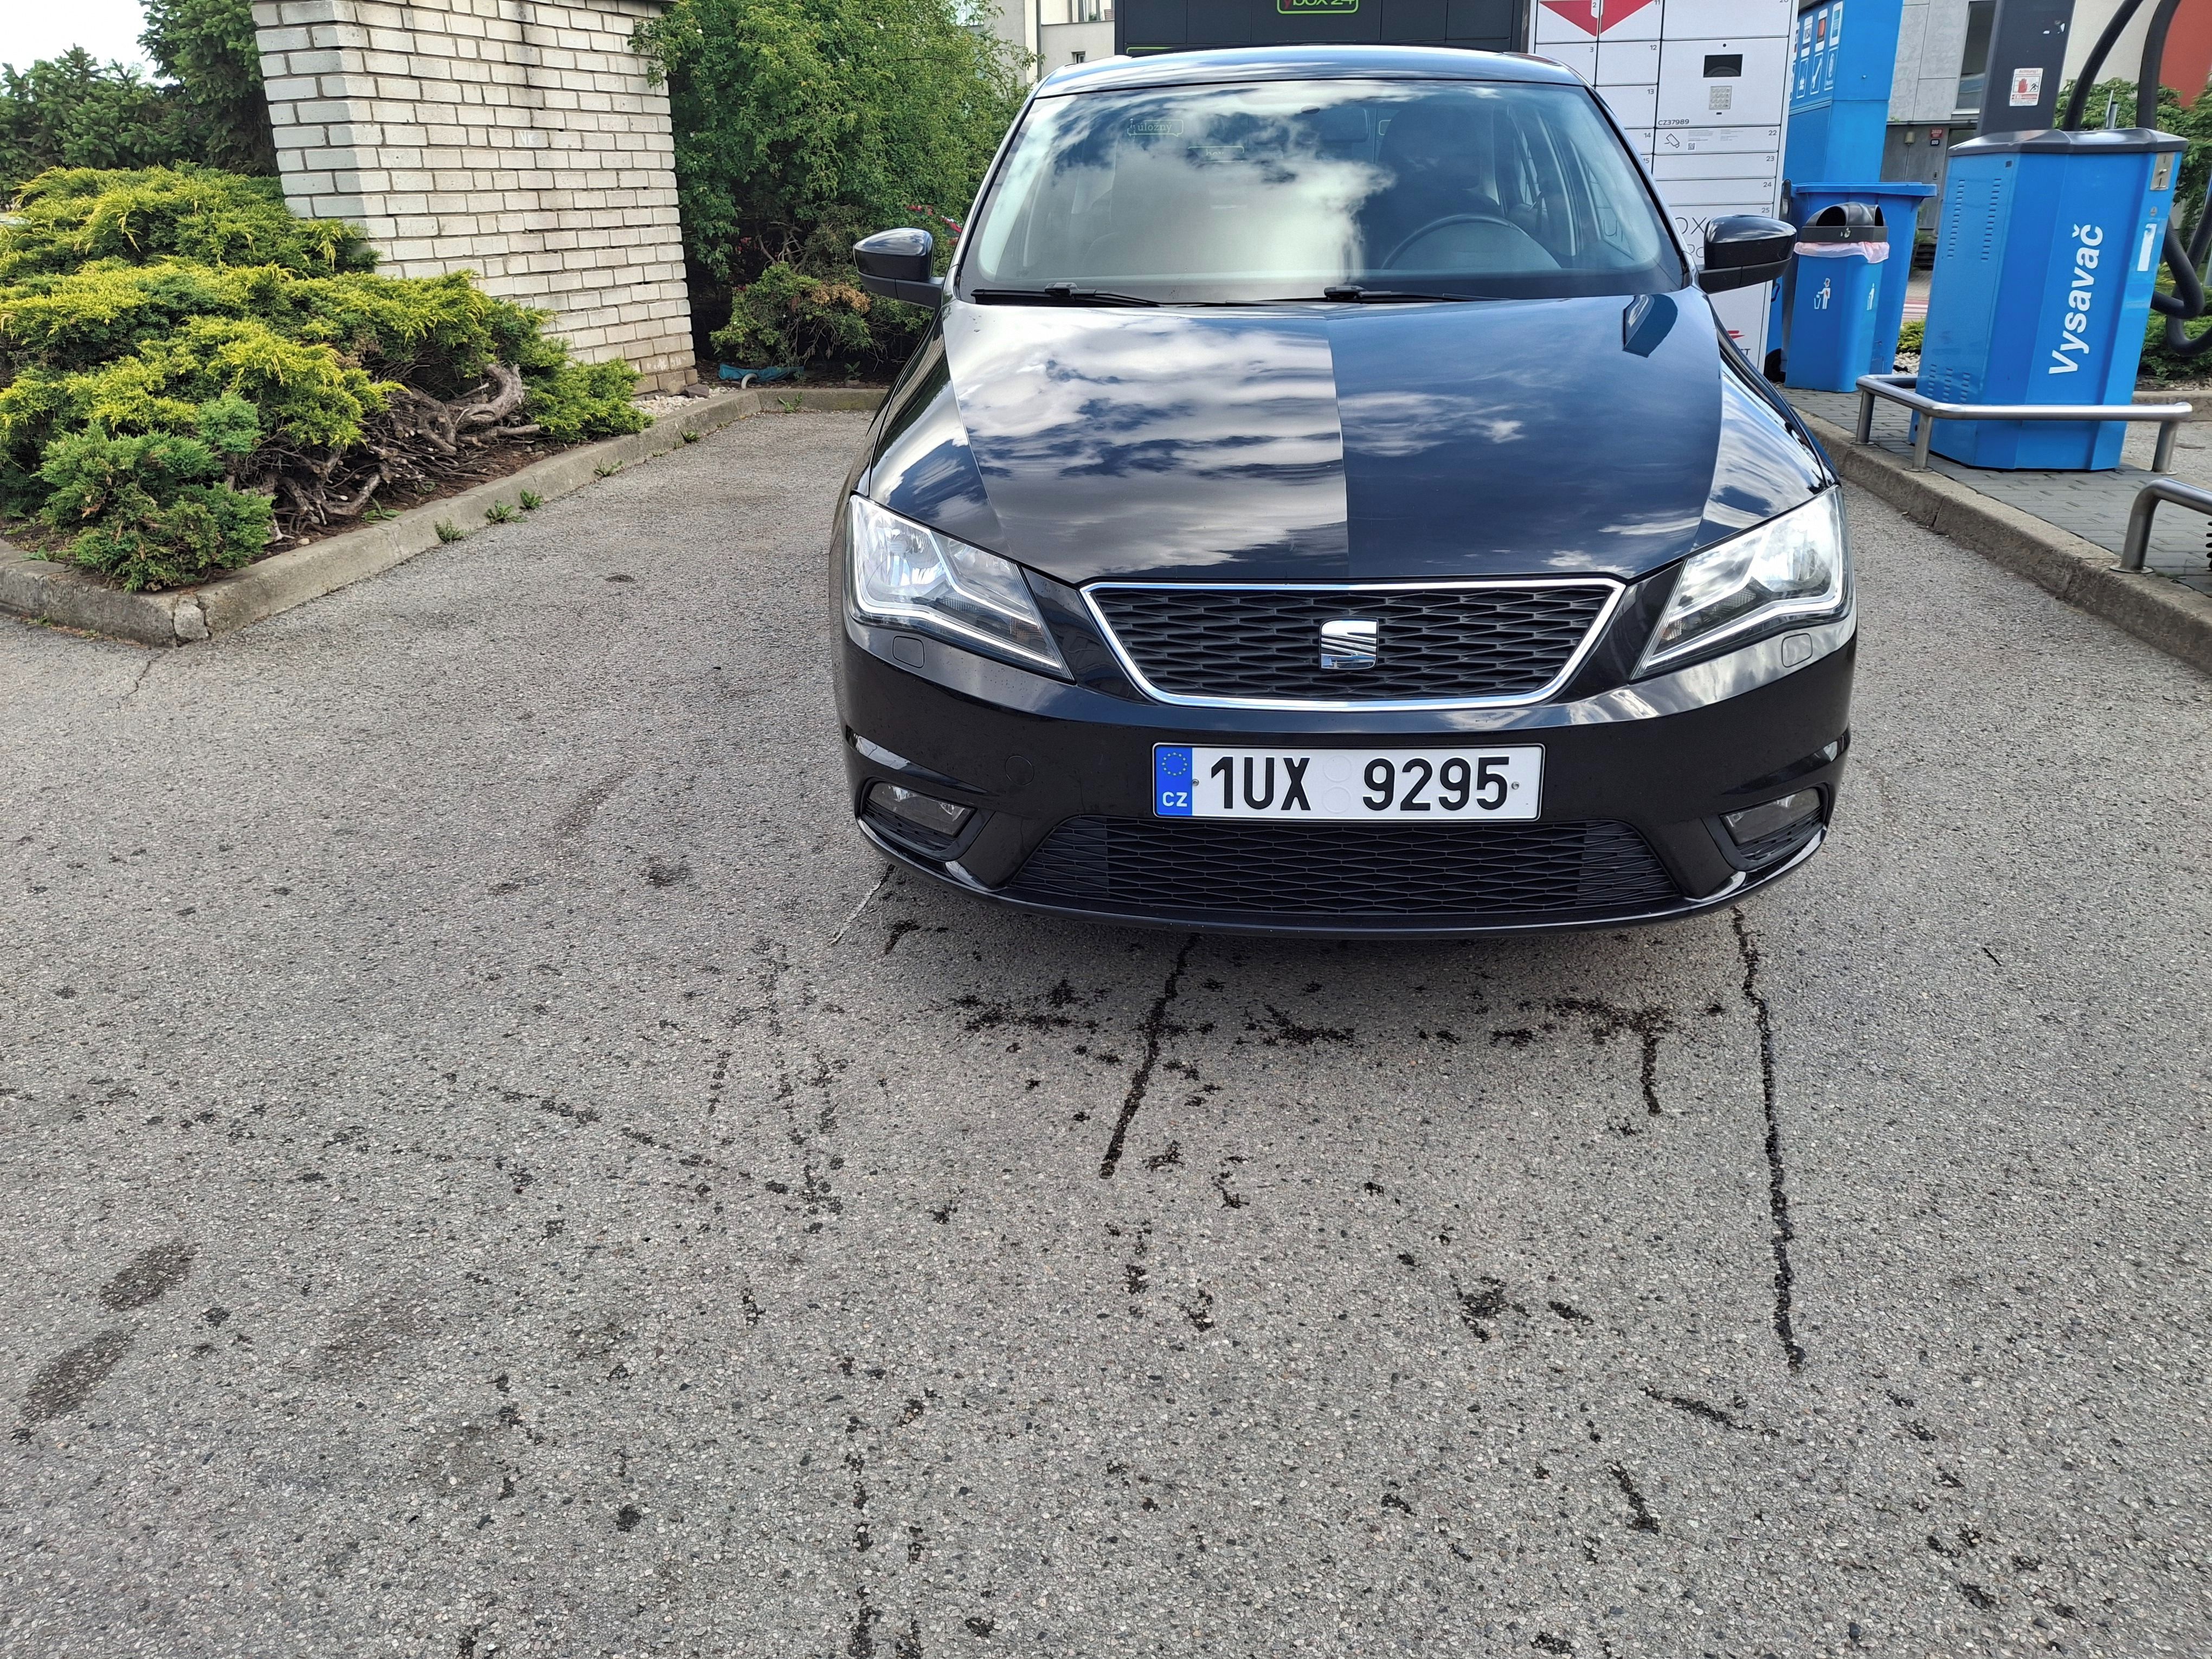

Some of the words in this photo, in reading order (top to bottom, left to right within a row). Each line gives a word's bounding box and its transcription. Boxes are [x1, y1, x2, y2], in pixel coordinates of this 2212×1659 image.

[1138, 120, 1172, 133] úložný
[2048, 223, 2104, 374] Vysavač
[1162, 792, 1188, 807] CZ
[1211, 756, 1311, 811] 1UX
[1362, 757, 1510, 812] 9295
